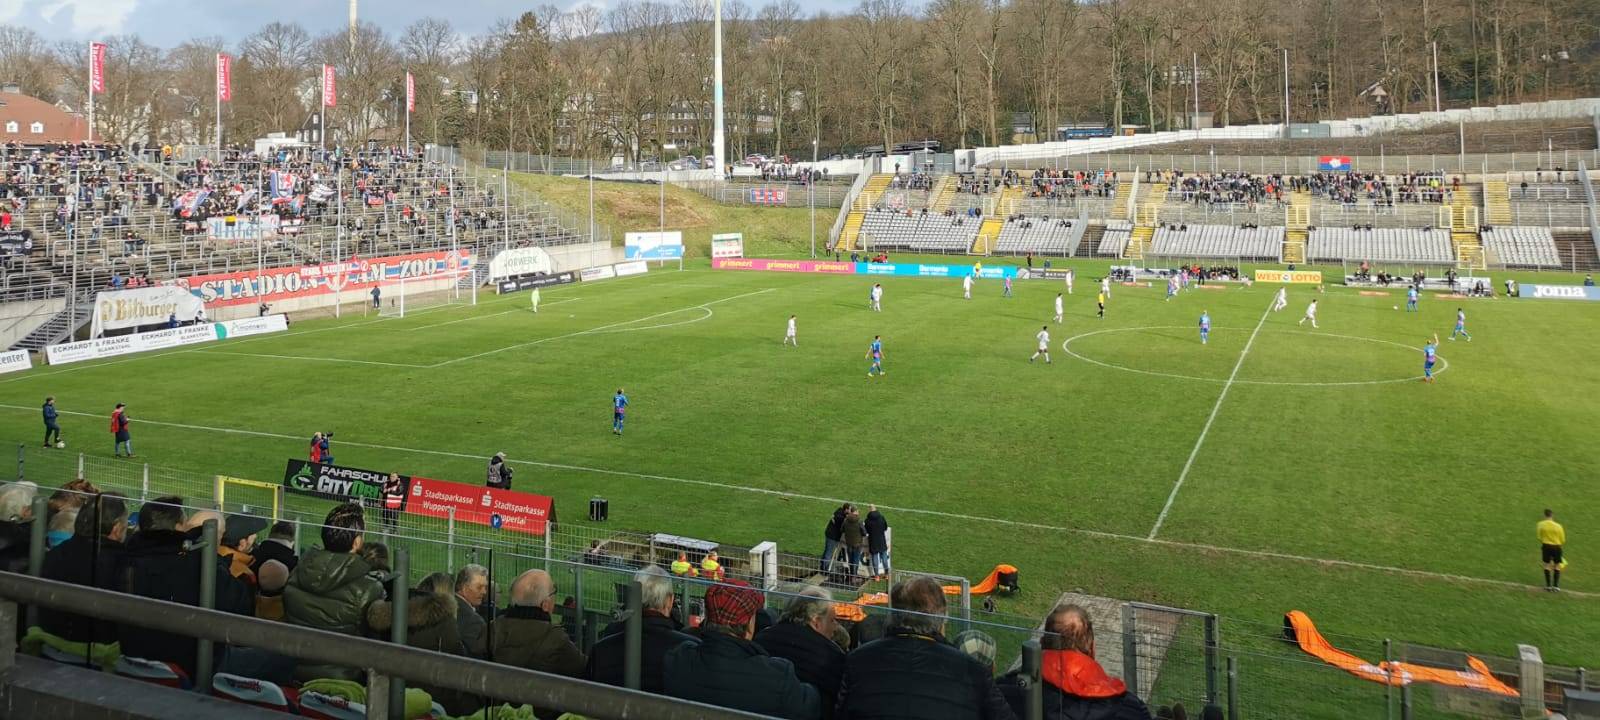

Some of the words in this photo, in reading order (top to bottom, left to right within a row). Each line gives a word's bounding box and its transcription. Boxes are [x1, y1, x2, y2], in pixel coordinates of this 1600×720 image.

[200, 272, 318, 303] STADION
[400, 258, 438, 278] ZOO
[1256, 273, 1281, 281] WEST
[1292, 273, 1321, 281] LOTTO
[141, 330, 176, 341] ECKHARDT
[184, 326, 209, 335] FRANKE
[52, 342, 92, 354] ECKHARDT
[0, 354, 24, 365] enter
[424, 489, 474, 505] Stadtsparkasse
[493, 500, 545, 518] Stadtsparkasse
